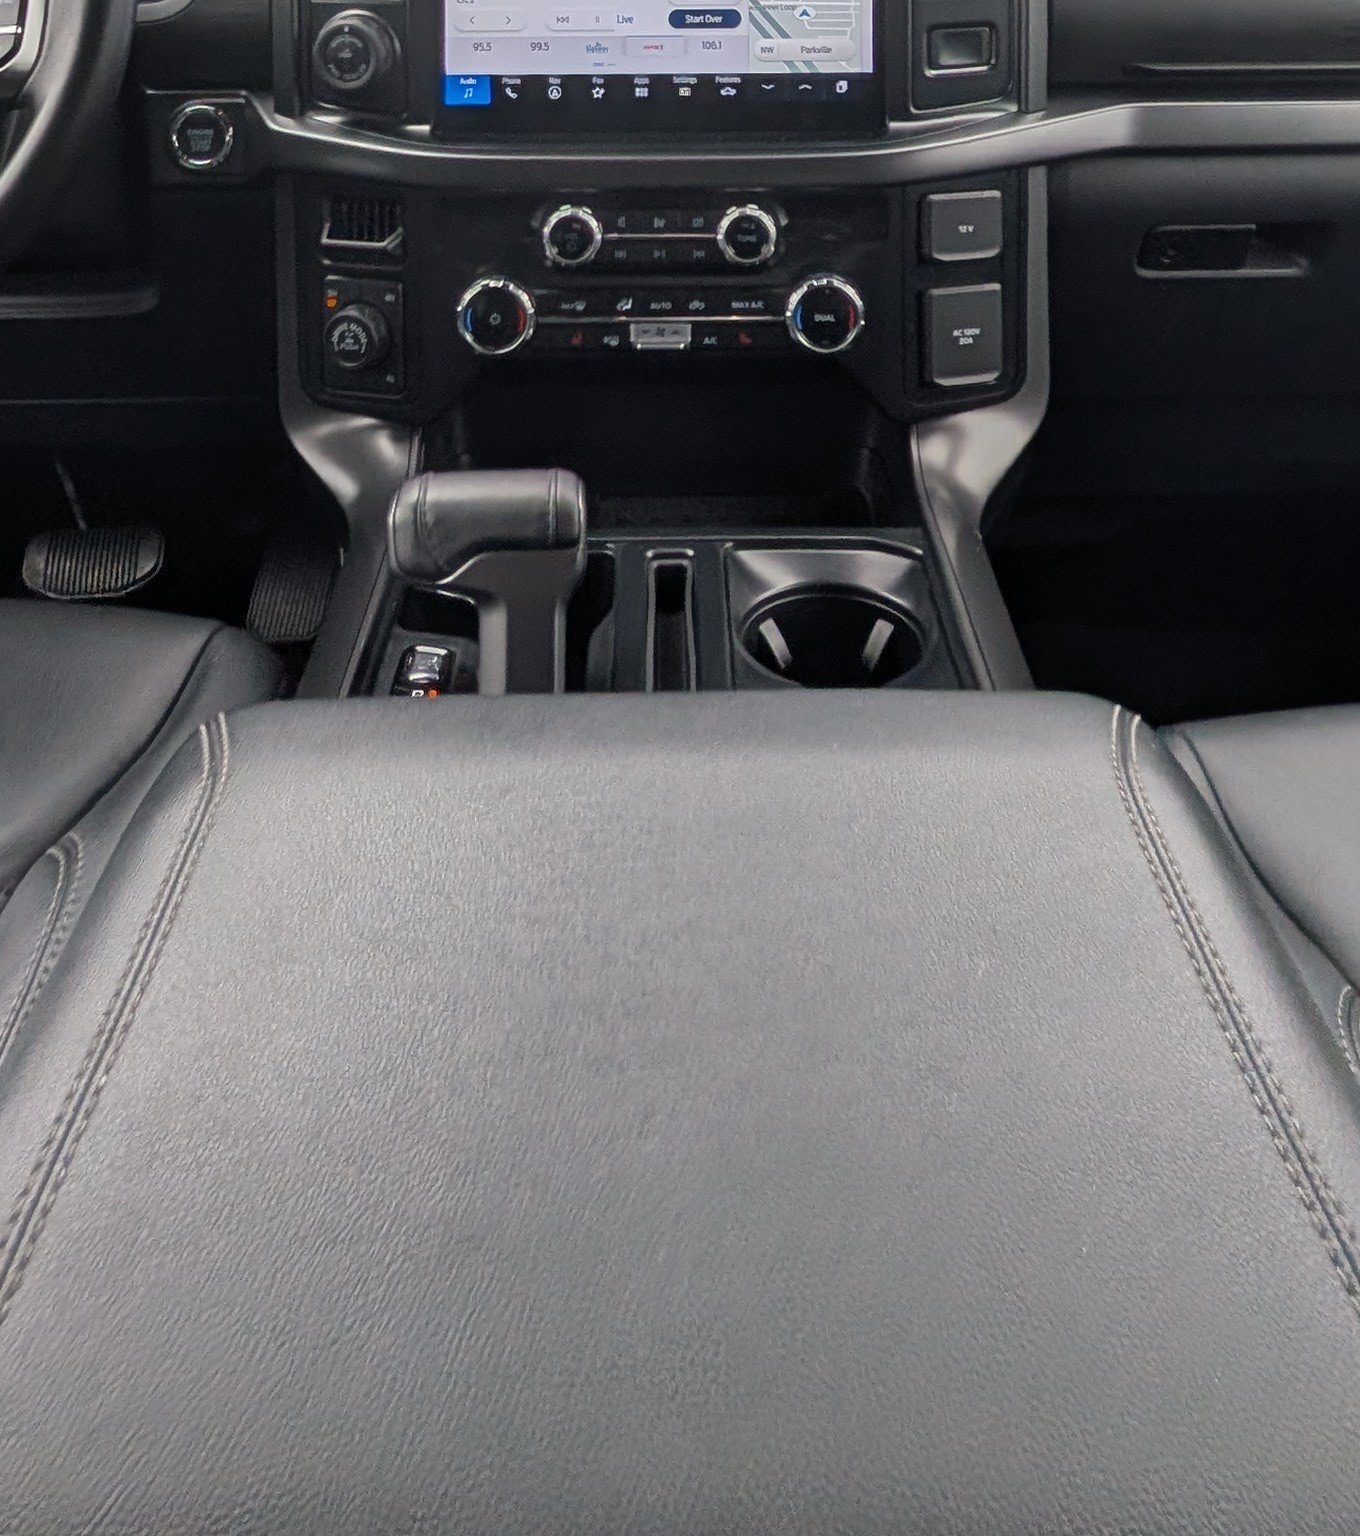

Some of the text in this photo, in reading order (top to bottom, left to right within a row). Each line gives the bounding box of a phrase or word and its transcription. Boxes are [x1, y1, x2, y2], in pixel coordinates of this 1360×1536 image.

[616, 14, 634, 25] Live
[685, 14, 724, 24] Start Over
[472, 42, 493, 52] 95.5
[530, 41, 551, 52] 99.5
[701, 41, 722, 50] 106.1
[459, 76, 478, 85] Audio
[673, 76, 698, 85] Settings
[650, 301, 672, 310] AUTO
[814, 313, 836, 323] DUAL
[953, 329, 963, 337] AC
